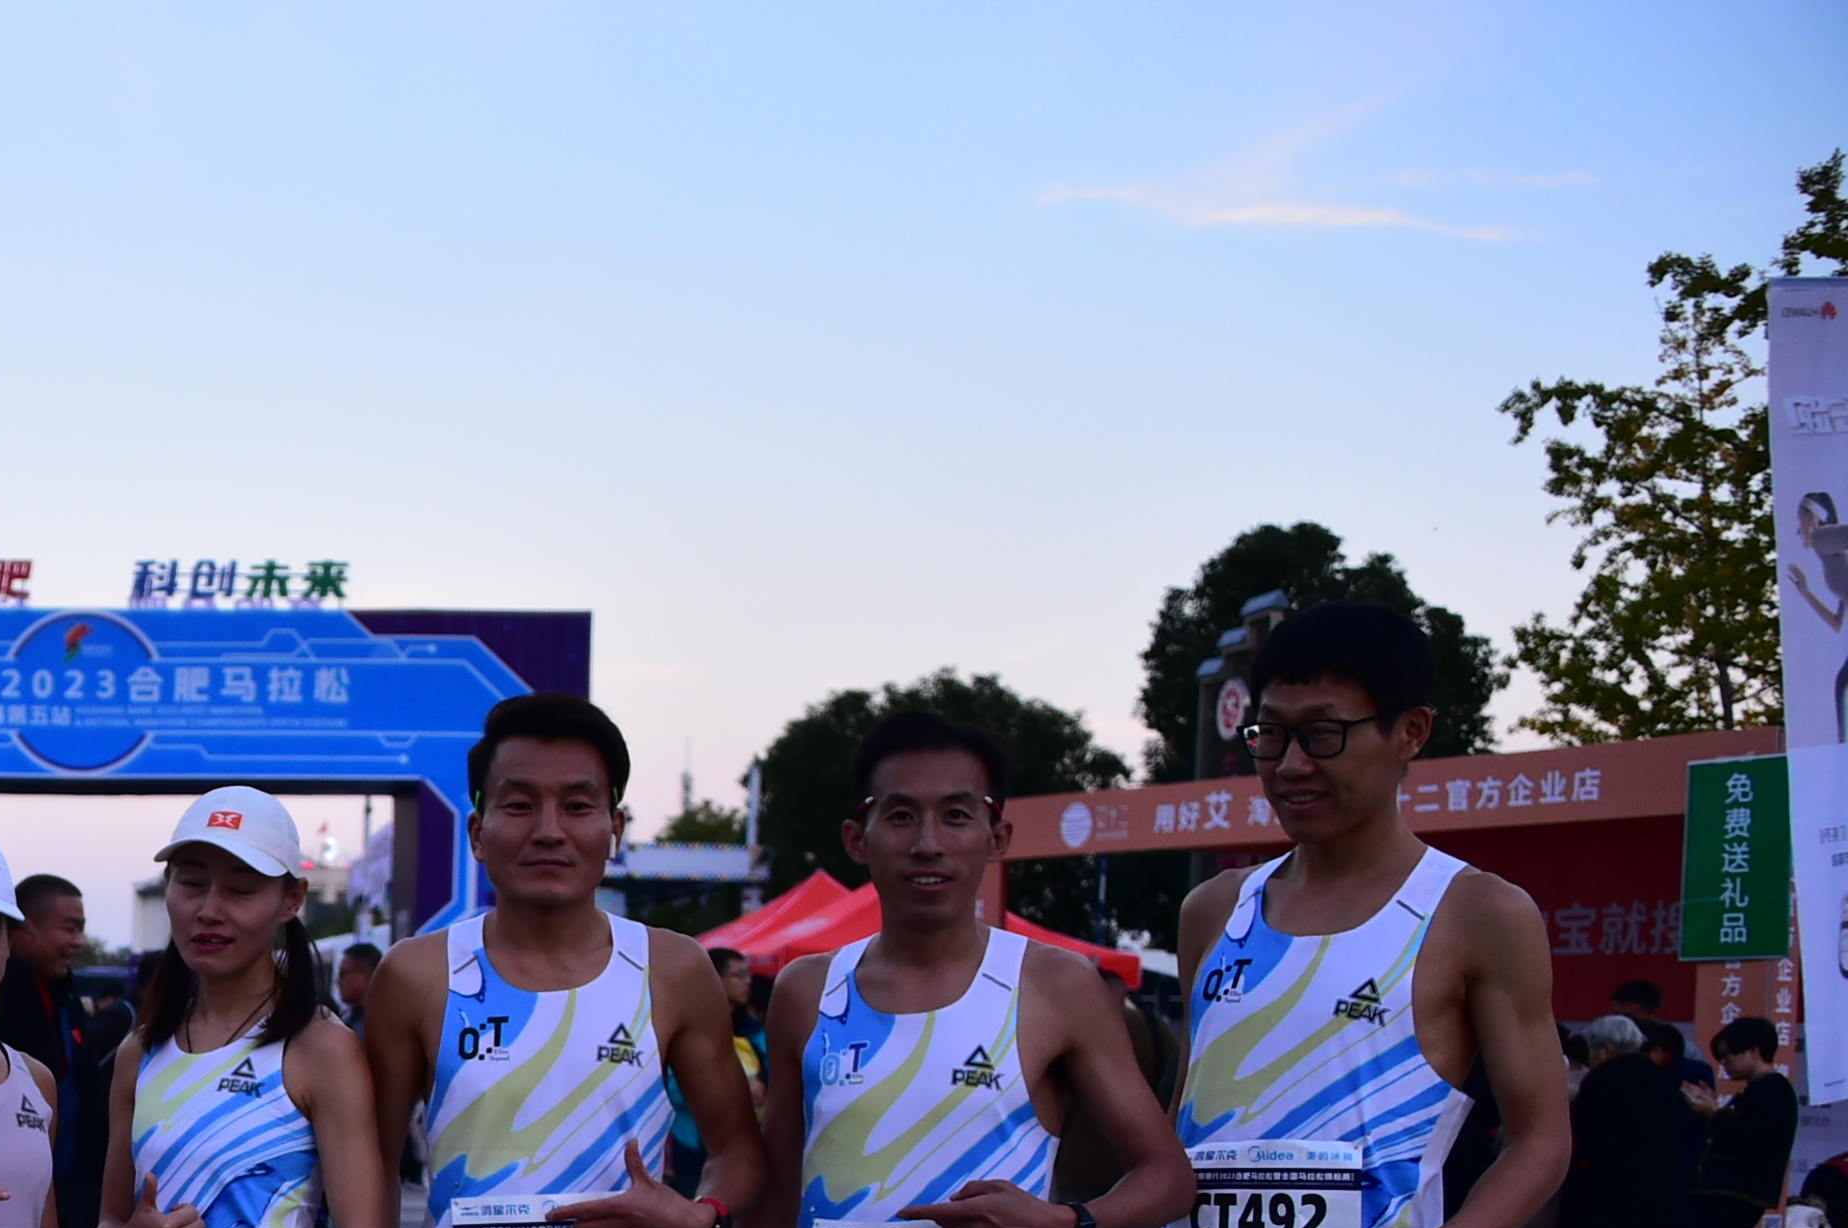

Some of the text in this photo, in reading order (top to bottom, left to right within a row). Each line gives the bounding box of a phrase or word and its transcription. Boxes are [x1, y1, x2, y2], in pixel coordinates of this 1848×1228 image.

[129, 559, 349, 598] 科创未来
[1718, 771, 1754, 944] 免费送礼品
[1334, 1001, 1390, 1027] PEAK
[597, 1047, 643, 1066] PEAK
[218, 1078, 265, 1098] PEAK
[952, 1070, 1003, 1090] PEAK
[16, 1113, 47, 1133] PEAK
[481, 1204, 531, 1216] 鸿星尔克
